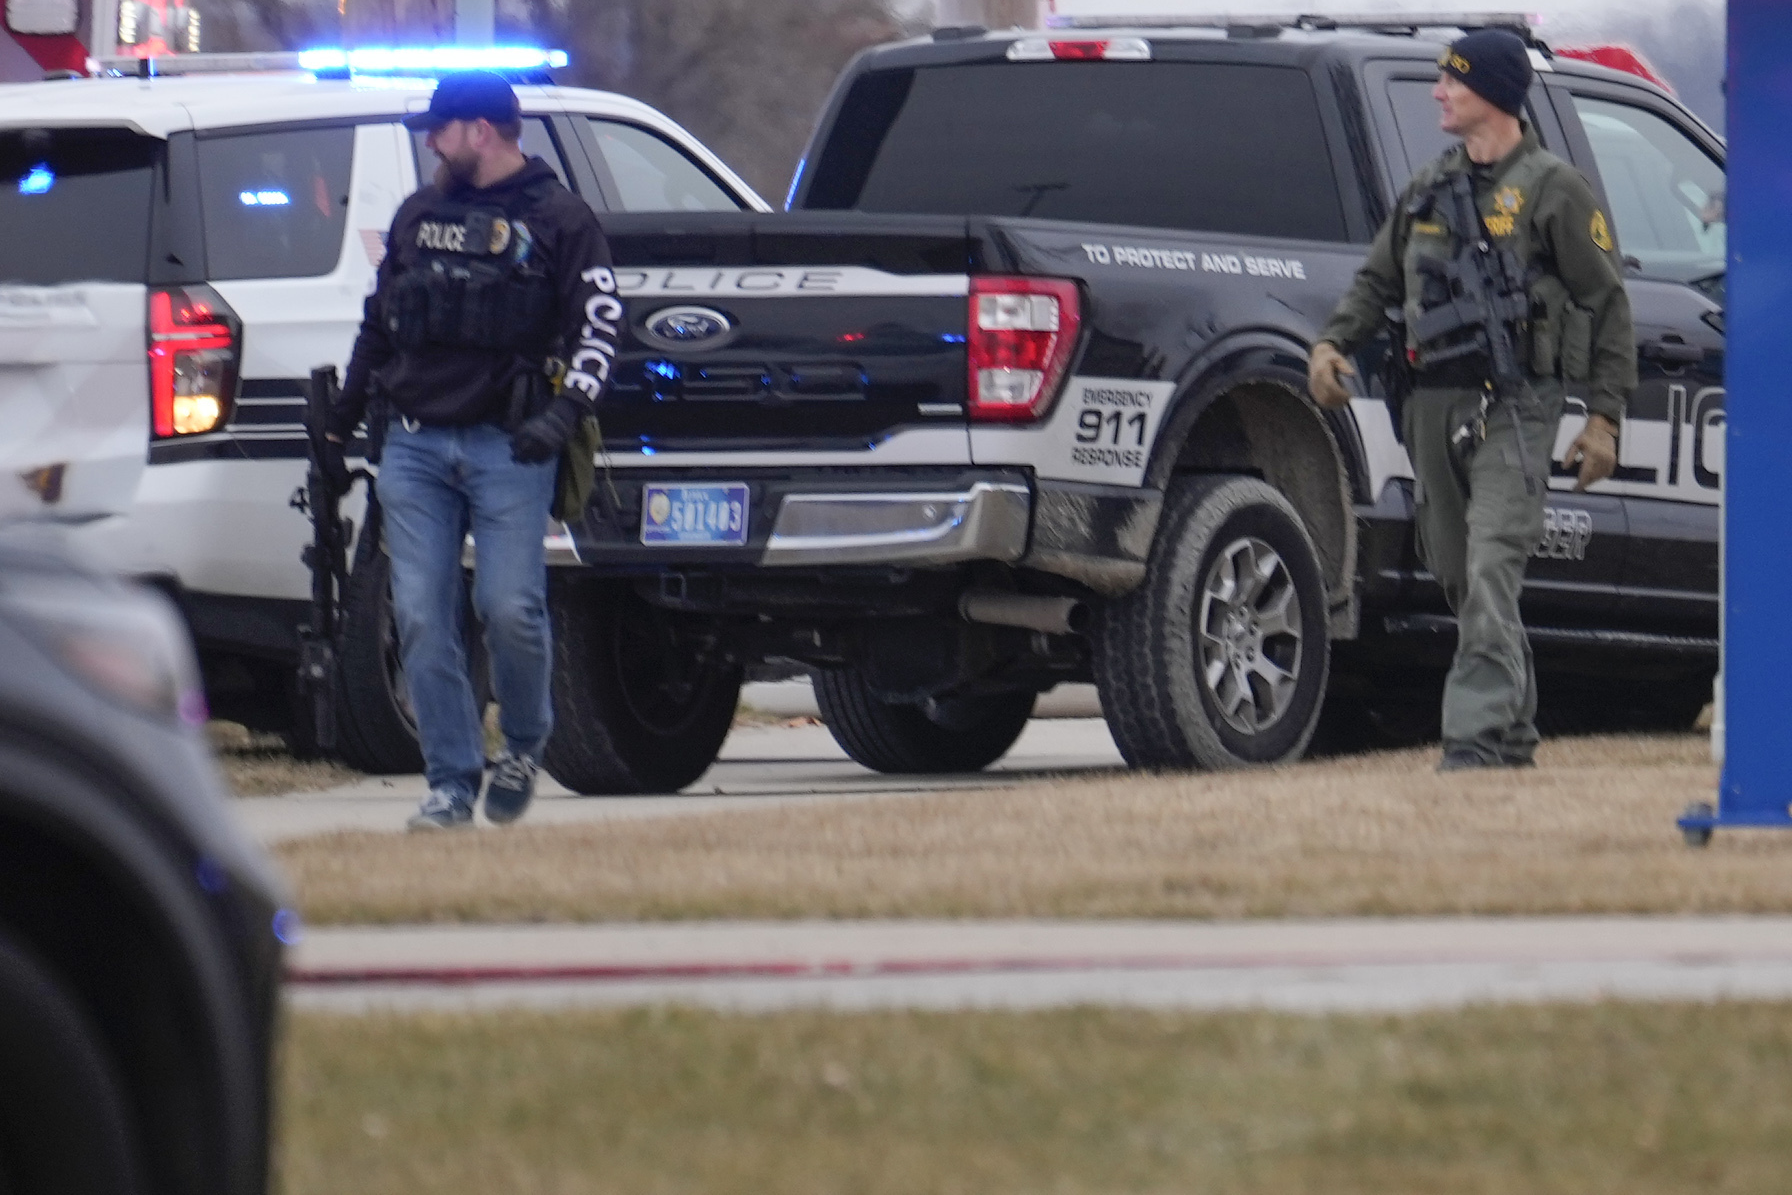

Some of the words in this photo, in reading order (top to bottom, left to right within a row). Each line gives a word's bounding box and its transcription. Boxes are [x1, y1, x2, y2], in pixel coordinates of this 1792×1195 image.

[416, 221, 467, 252] POLICE
[1081, 242, 1111, 266] TO
[1112, 245, 1197, 272] PROTECT
[1202, 252, 1243, 275] AND
[1244, 256, 1307, 281] SERVE
[1082, 387, 1154, 409] EMERGENCY
[1075, 408, 1147, 446] 911
[1071, 446, 1144, 469] RESPONSE
